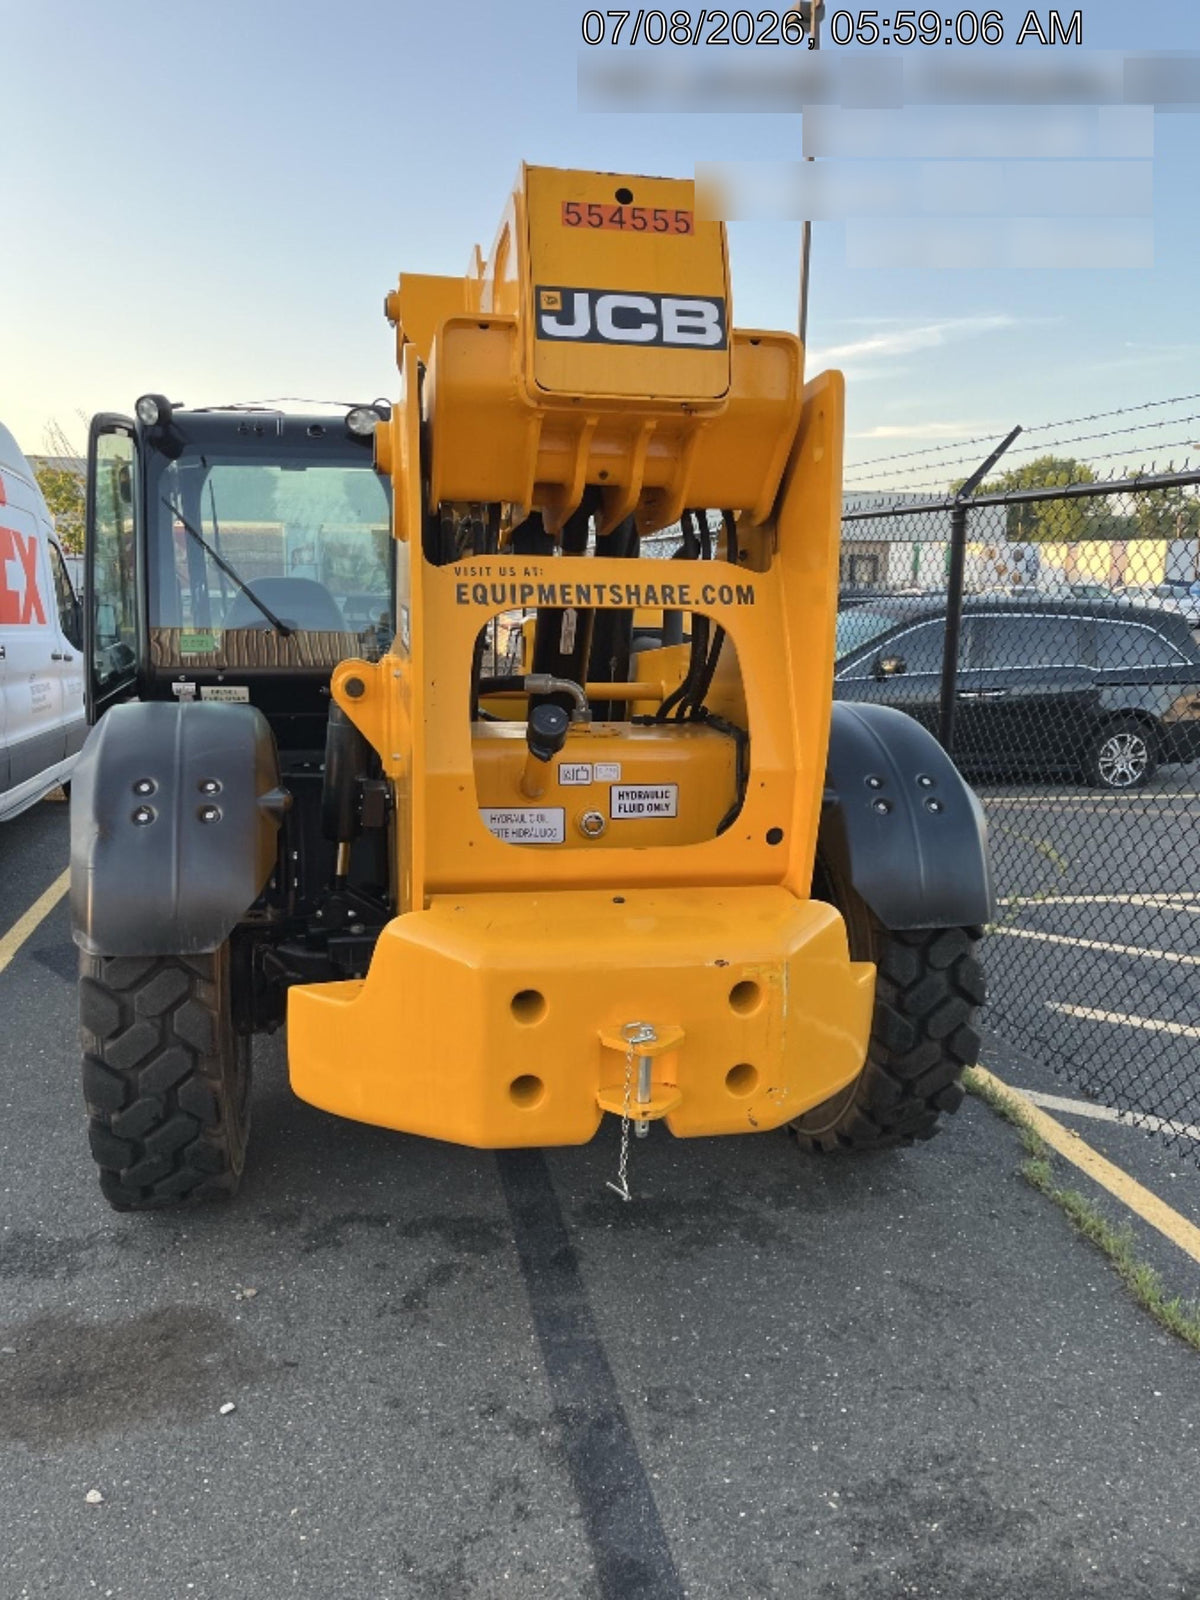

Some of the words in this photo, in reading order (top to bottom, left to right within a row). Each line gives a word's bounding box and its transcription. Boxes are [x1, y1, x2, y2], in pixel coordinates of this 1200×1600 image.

[564, 202, 691, 234] 554555
[541, 292, 723, 346] JCB
[454, 566, 491, 577] VISIT
[499, 567, 517, 577] US
[524, 567, 544, 577] AT:
[456, 582, 756, 606] EQUIPMENTSHARE.COM
[618, 790, 671, 801] HYDRAULIC
[618, 802, 645, 813] FLUID
[646, 802, 671, 813] ONLY
[489, 813, 535, 824] HYDRAULC
